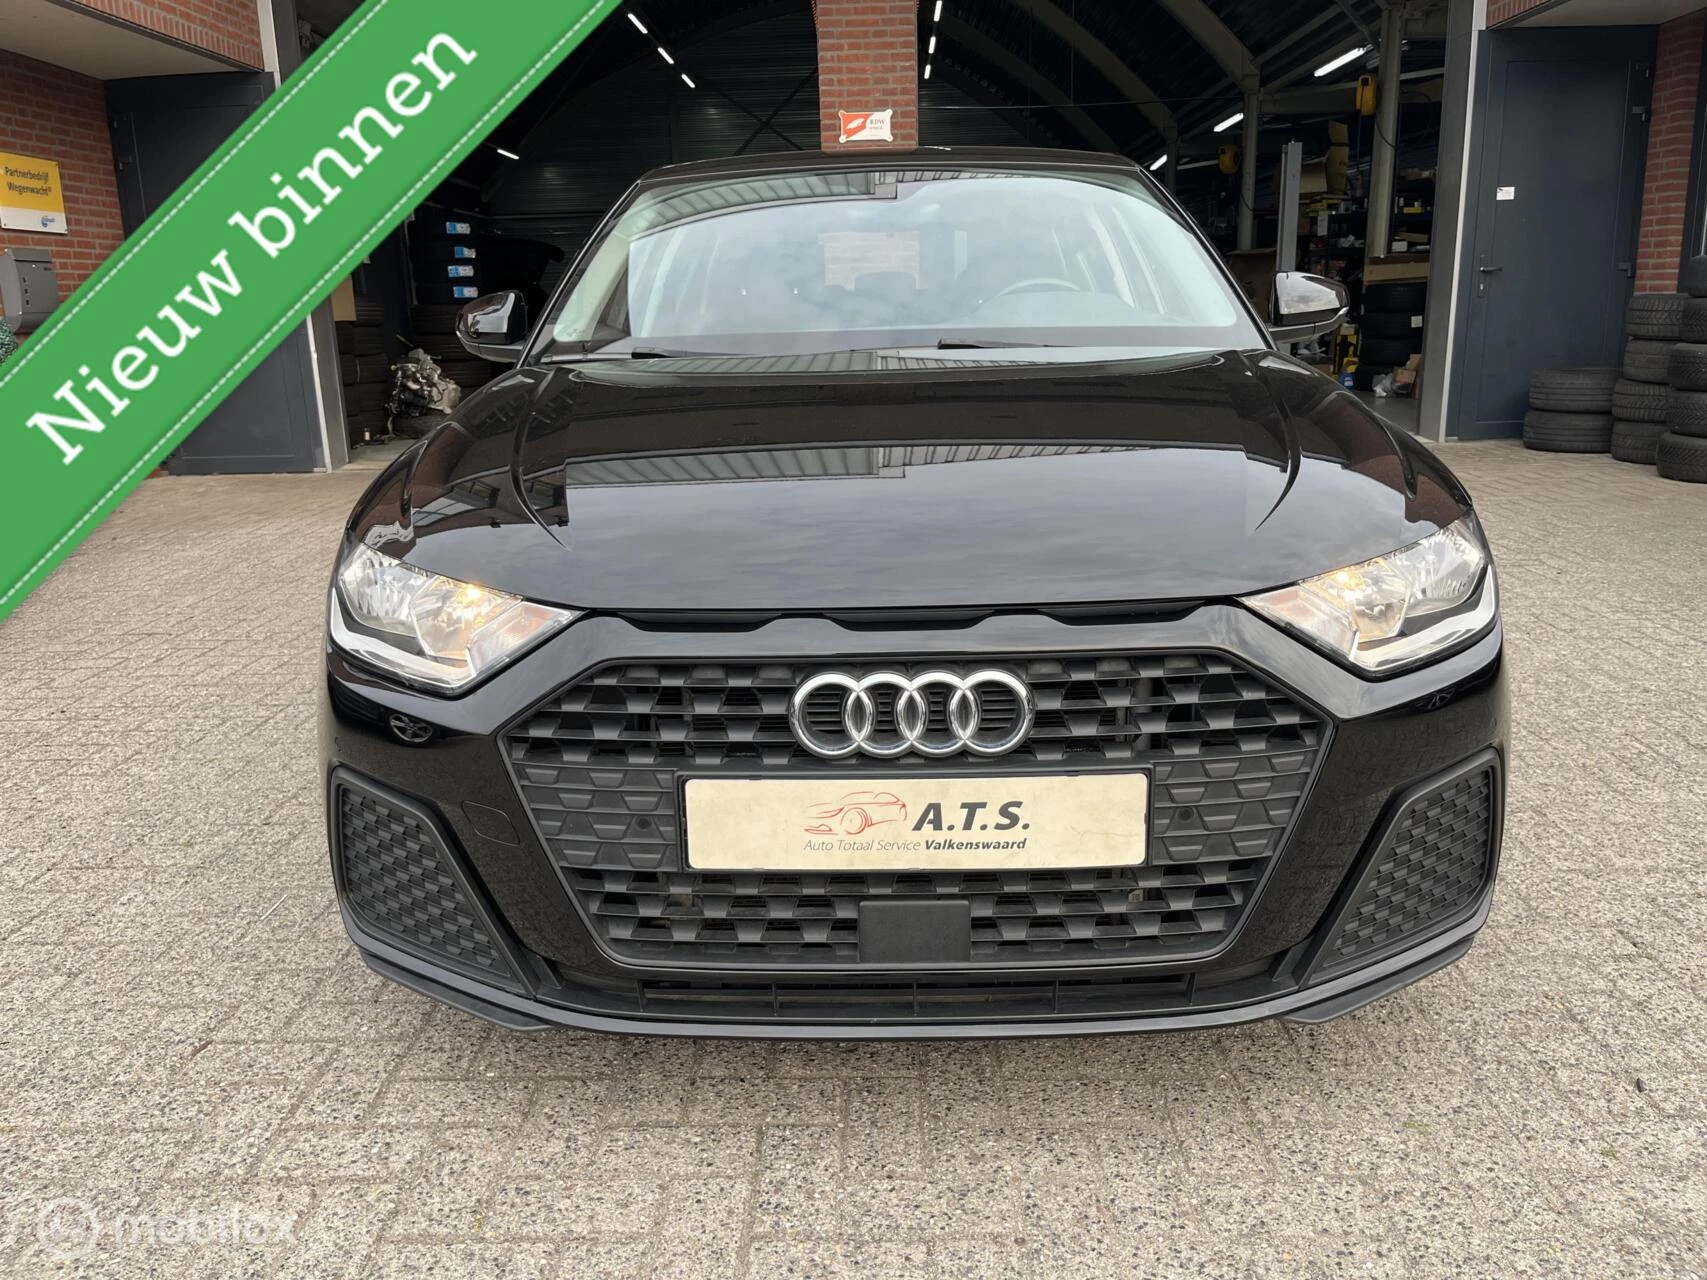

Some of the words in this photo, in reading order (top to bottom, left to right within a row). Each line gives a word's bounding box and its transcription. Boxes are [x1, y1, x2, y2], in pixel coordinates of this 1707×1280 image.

[5, 167, 49, 184] Partnerbedrijf
[912, 801, 1030, 832] A.T.S.
[803, 840, 834, 851] Auto
[837, 840, 874, 851] Totaal
[876, 840, 921, 851] Service
[924, 839, 1028, 851] Valkenswaard
